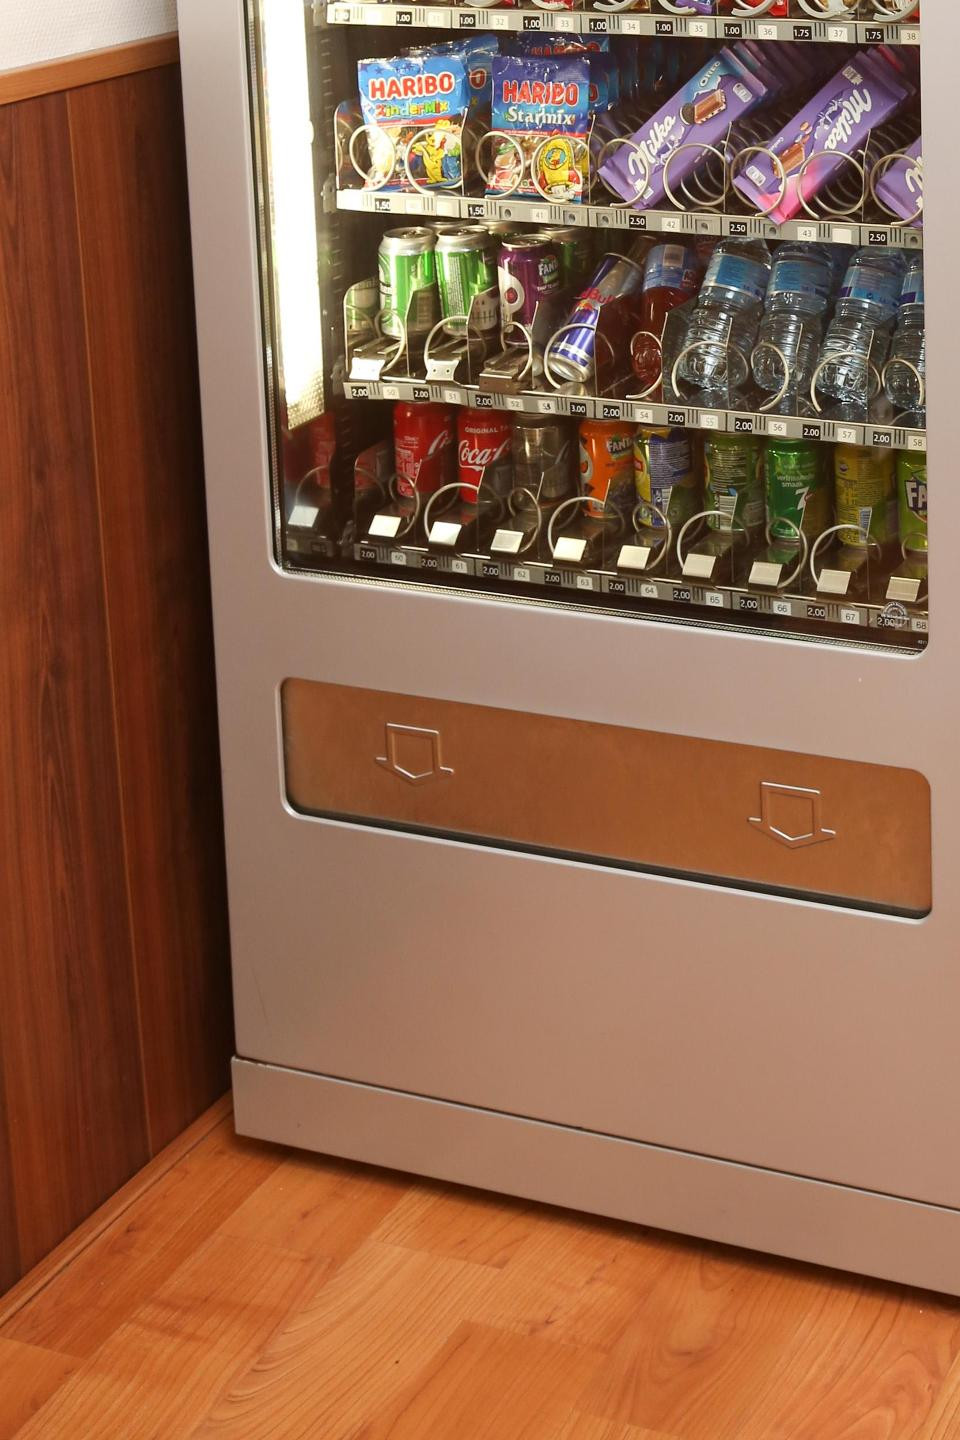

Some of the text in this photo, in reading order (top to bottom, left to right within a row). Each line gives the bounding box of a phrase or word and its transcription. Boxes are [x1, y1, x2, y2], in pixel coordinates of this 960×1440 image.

[396, 14, 410, 22] 1.00
[460, 16, 474, 24] 1.00
[656, 23, 671, 31] 1.00
[695, 24, 703, 32] 35
[724, 26, 739, 34] 1.00
[794, 29, 809, 37] 1.75
[834, 29, 843, 38] 37
[865, 31, 881, 39] 1.75
[907, 32, 916, 40] 38
[370, 73, 455, 99] HARIBO
[502, 81, 579, 104] HARIBO
[508, 107, 574, 126] Starmix
[824, 89, 872, 150] Milka
[628, 115, 676, 176] Milka
[629, 217, 646, 226] 2.50
[666, 221, 676, 229] 42
[730, 224, 746, 233] 2.50
[803, 230, 812, 238] 43
[870, 233, 886, 242] 2.50
[414, 390, 428, 398] 2.00
[571, 405, 585, 413] 3.00
[668, 414, 684, 423] 2.00
[735, 421, 752, 430] 2.00
[772, 424, 782, 432] 56
[804, 428, 819, 437] 2.00
[842, 431, 852, 439] 57
[874, 434, 890, 443] 2.00
[913, 439, 923, 447] 58
[545, 574, 559, 582] 2.00
[710, 596, 720, 604] 65
[740, 600, 757, 608] 2.00
[777, 604, 787, 612] 66
[808, 608, 825, 616] 2.00
[845, 613, 855, 621] 67
